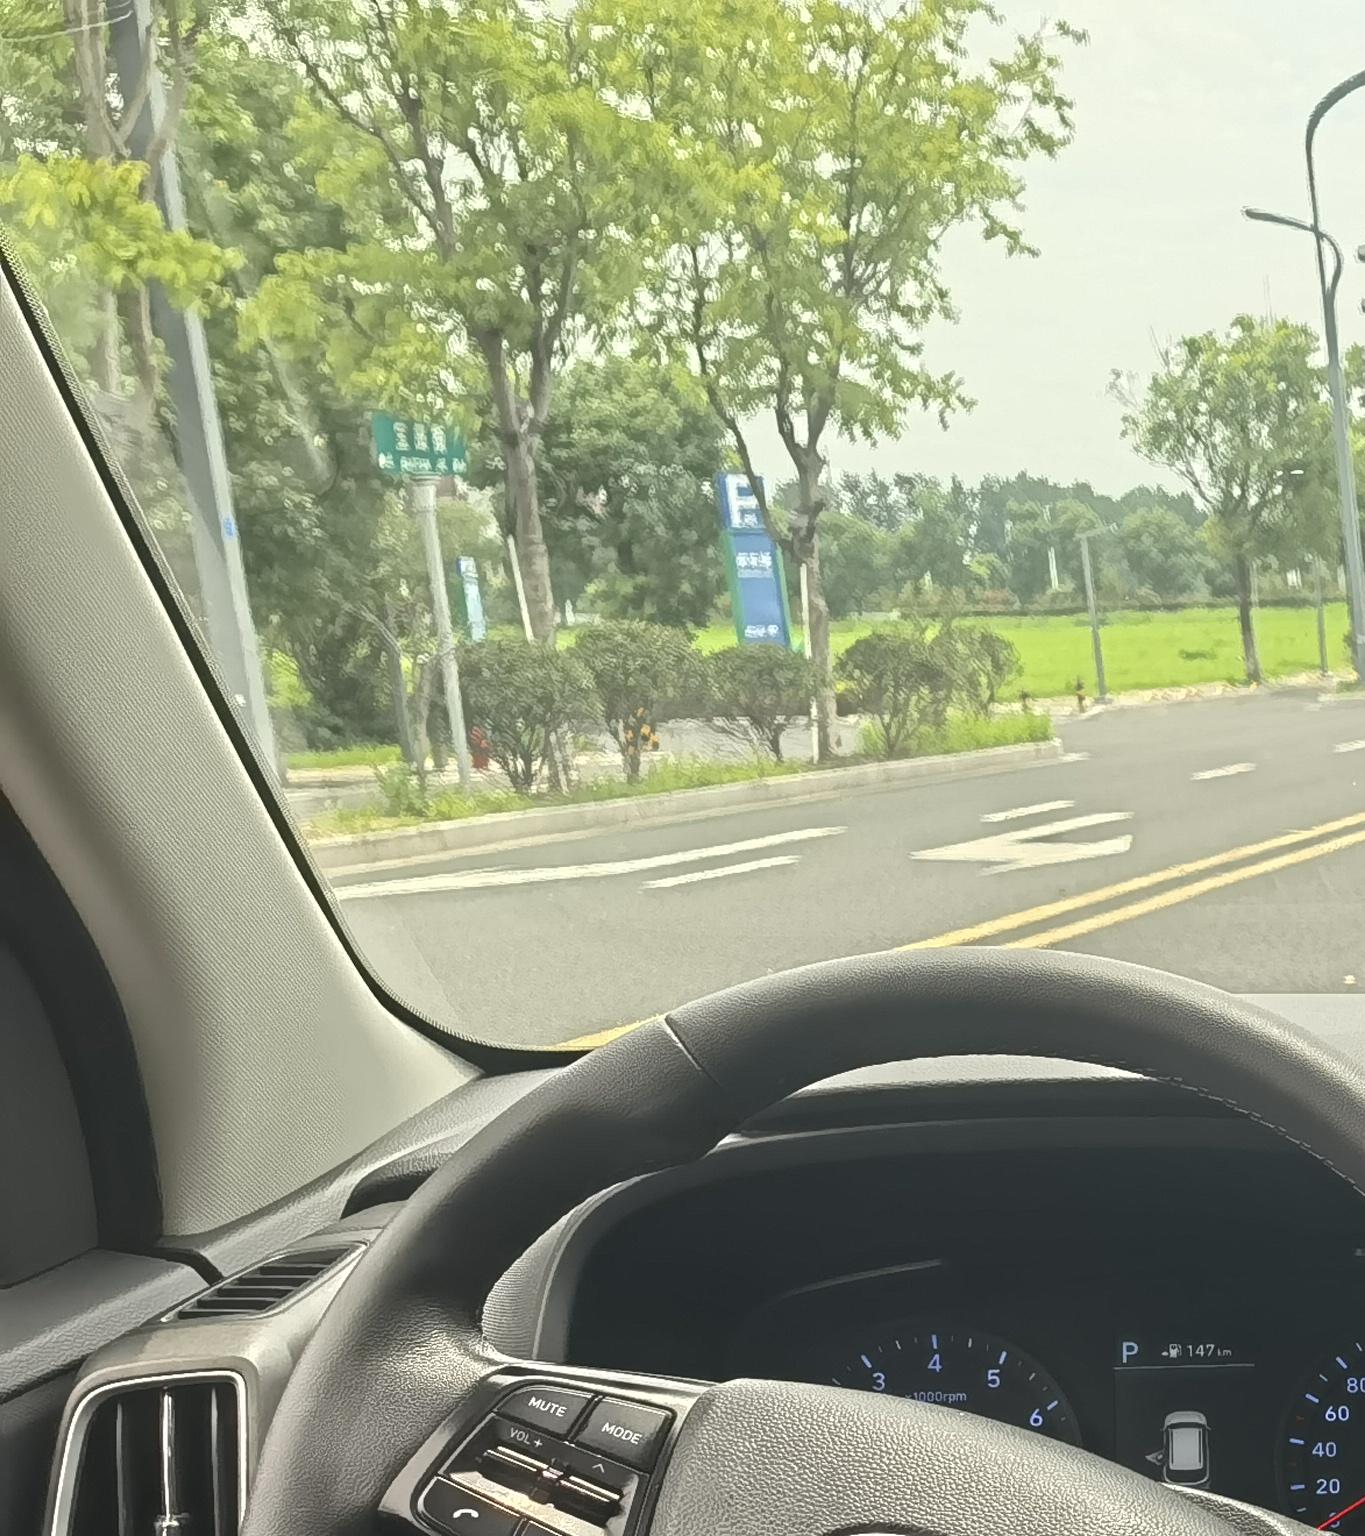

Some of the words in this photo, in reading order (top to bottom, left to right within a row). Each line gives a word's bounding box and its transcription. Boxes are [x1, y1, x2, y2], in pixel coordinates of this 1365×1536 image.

[1121, 1341, 1139, 1363] P
[1187, 1343, 1215, 1357] 147
[1217, 1347, 1232, 1357] km
[927, 1354, 943, 1372] 4
[872, 1372, 886, 1391] 3
[987, 1369, 1001, 1388] 5
[527, 1396, 567, 1418] MUTE
[1325, 1405, 1350, 1421] 60
[1028, 1408, 1044, 1427] 6
[509, 1426, 531, 1446] VOL
[601, 1421, 642, 1445] MODE
[1311, 1441, 1337, 1457] 40
[1316, 1478, 1341, 1495] 20
